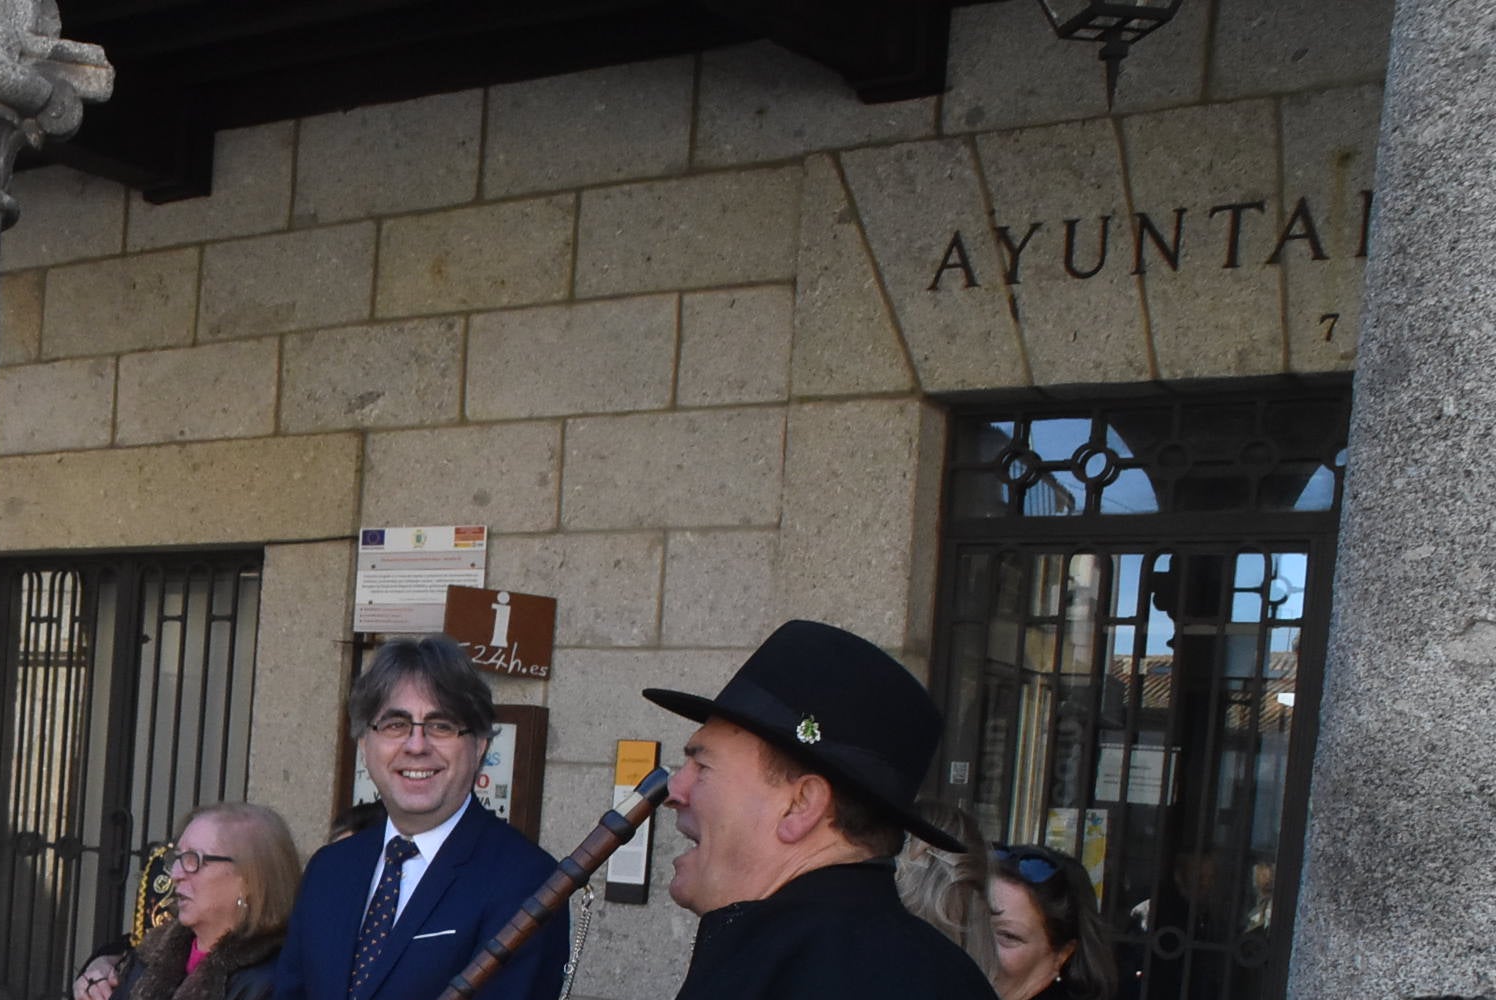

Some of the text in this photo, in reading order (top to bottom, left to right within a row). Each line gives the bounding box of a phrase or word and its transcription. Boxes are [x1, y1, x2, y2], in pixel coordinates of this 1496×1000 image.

[1319, 313, 1340, 342] 7
[457, 641, 548, 677] 24h.es
[477, 774, 490, 789] O
